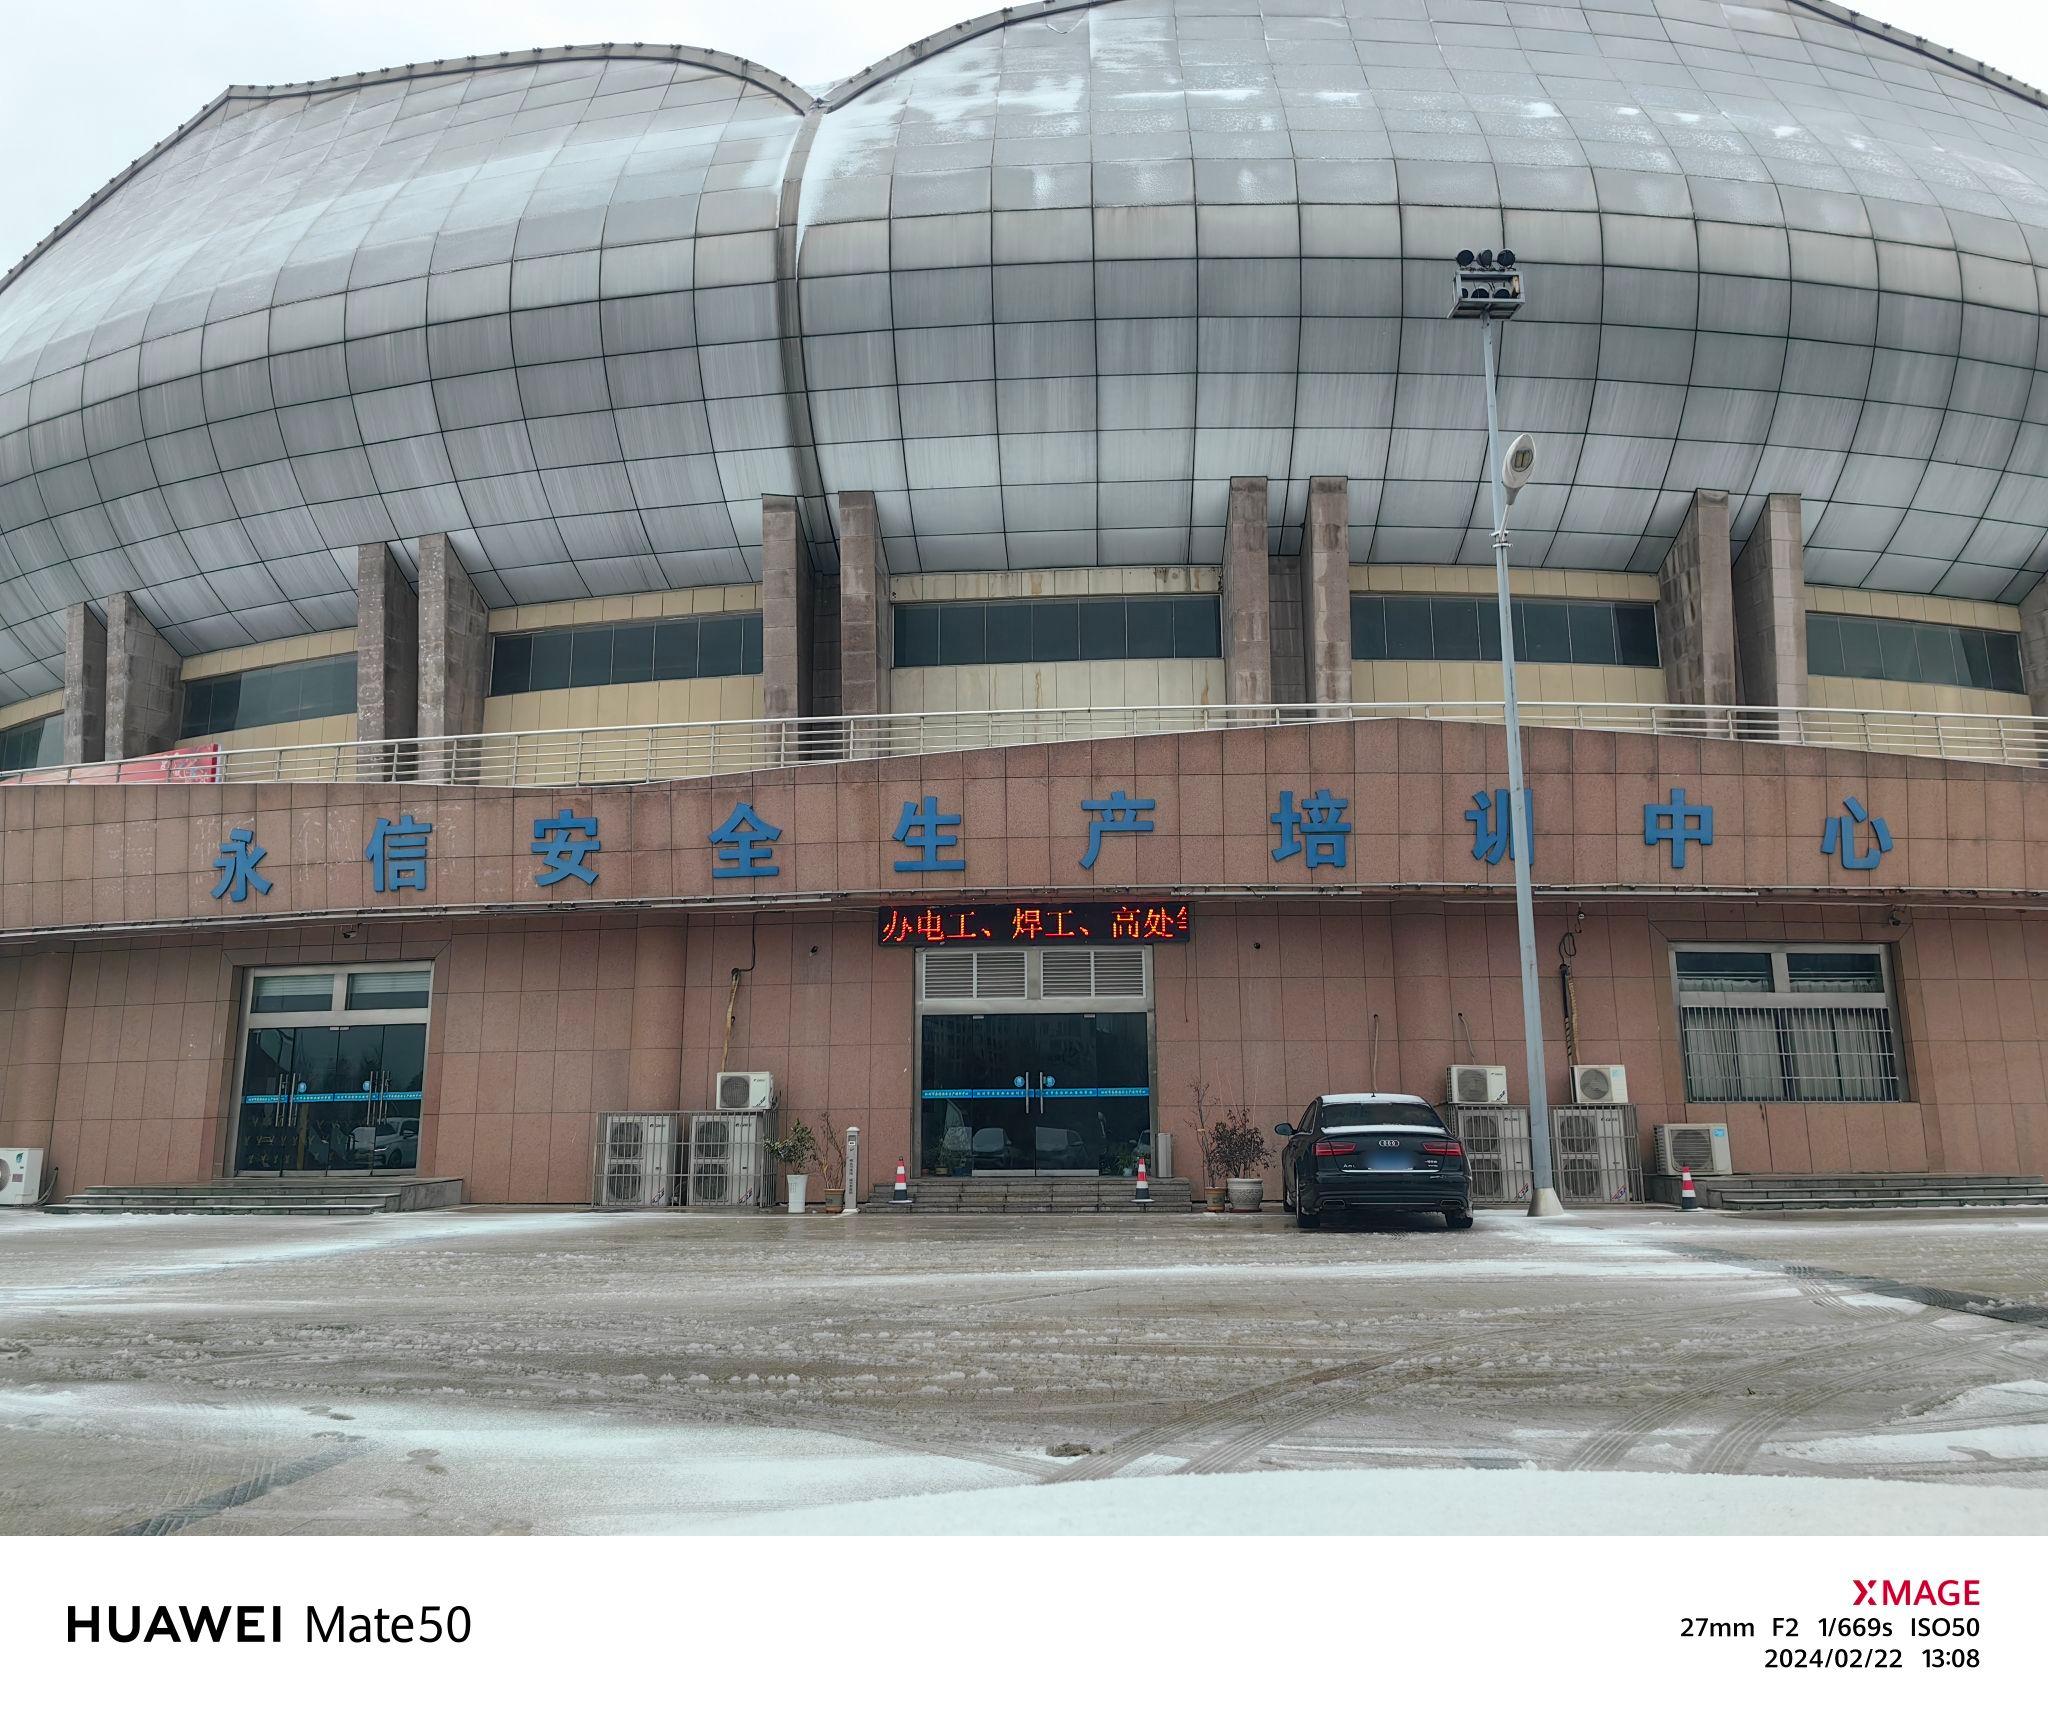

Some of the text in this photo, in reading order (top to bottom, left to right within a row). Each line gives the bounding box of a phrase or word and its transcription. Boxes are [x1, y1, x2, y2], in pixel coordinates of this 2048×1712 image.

[212, 788, 1894, 902] 永信安全生产培训中心
